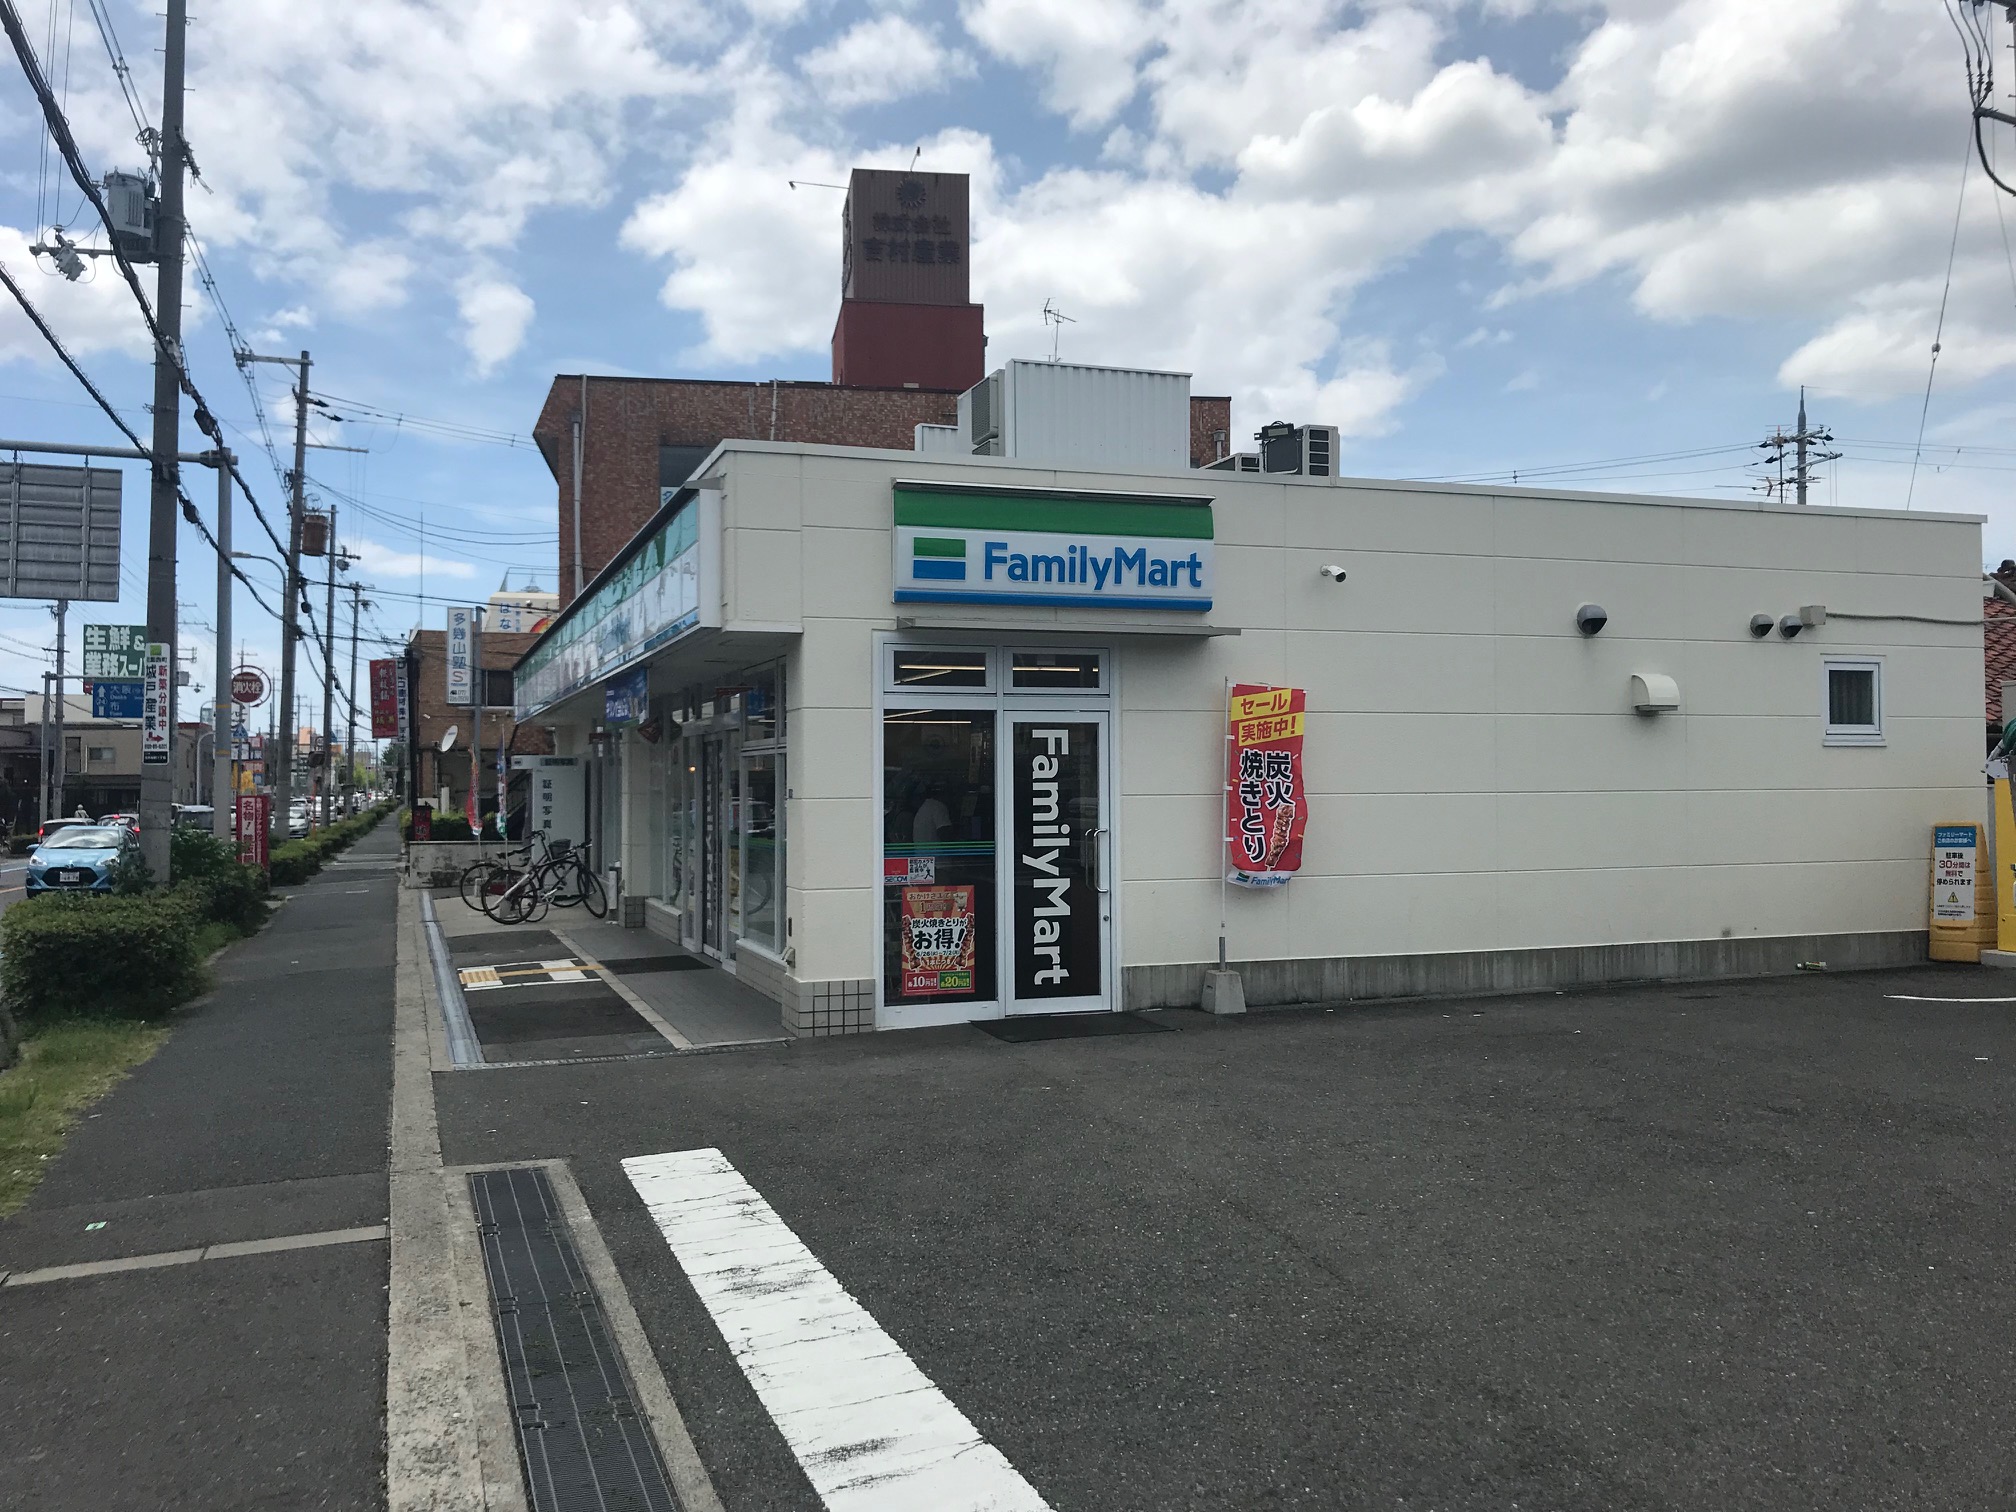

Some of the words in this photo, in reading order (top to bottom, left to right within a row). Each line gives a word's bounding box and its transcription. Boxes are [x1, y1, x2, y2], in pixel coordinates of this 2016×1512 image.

[984, 541, 1202, 591] FamilyMart
[233, 681, 261, 694] 消火栓
[1241, 693, 1287, 716] セール
[1241, 715, 1297, 743] 実施中!
[1266, 751, 1295, 809] 炭火
[543, 779, 552, 829] 証明写真
[1240, 750, 1266, 861] 焼きとり
[1022, 729, 1071, 985] FamilyMart
[1938, 860, 1971, 869] 30分間は
[1945, 851, 1964, 860] 駐車後
[885, 875, 908, 883] SECOM
[1936, 878, 1972, 886] 停められます
[912, 919, 967, 929] 炭火焼きとりが
[913, 928, 966, 950] お得!
